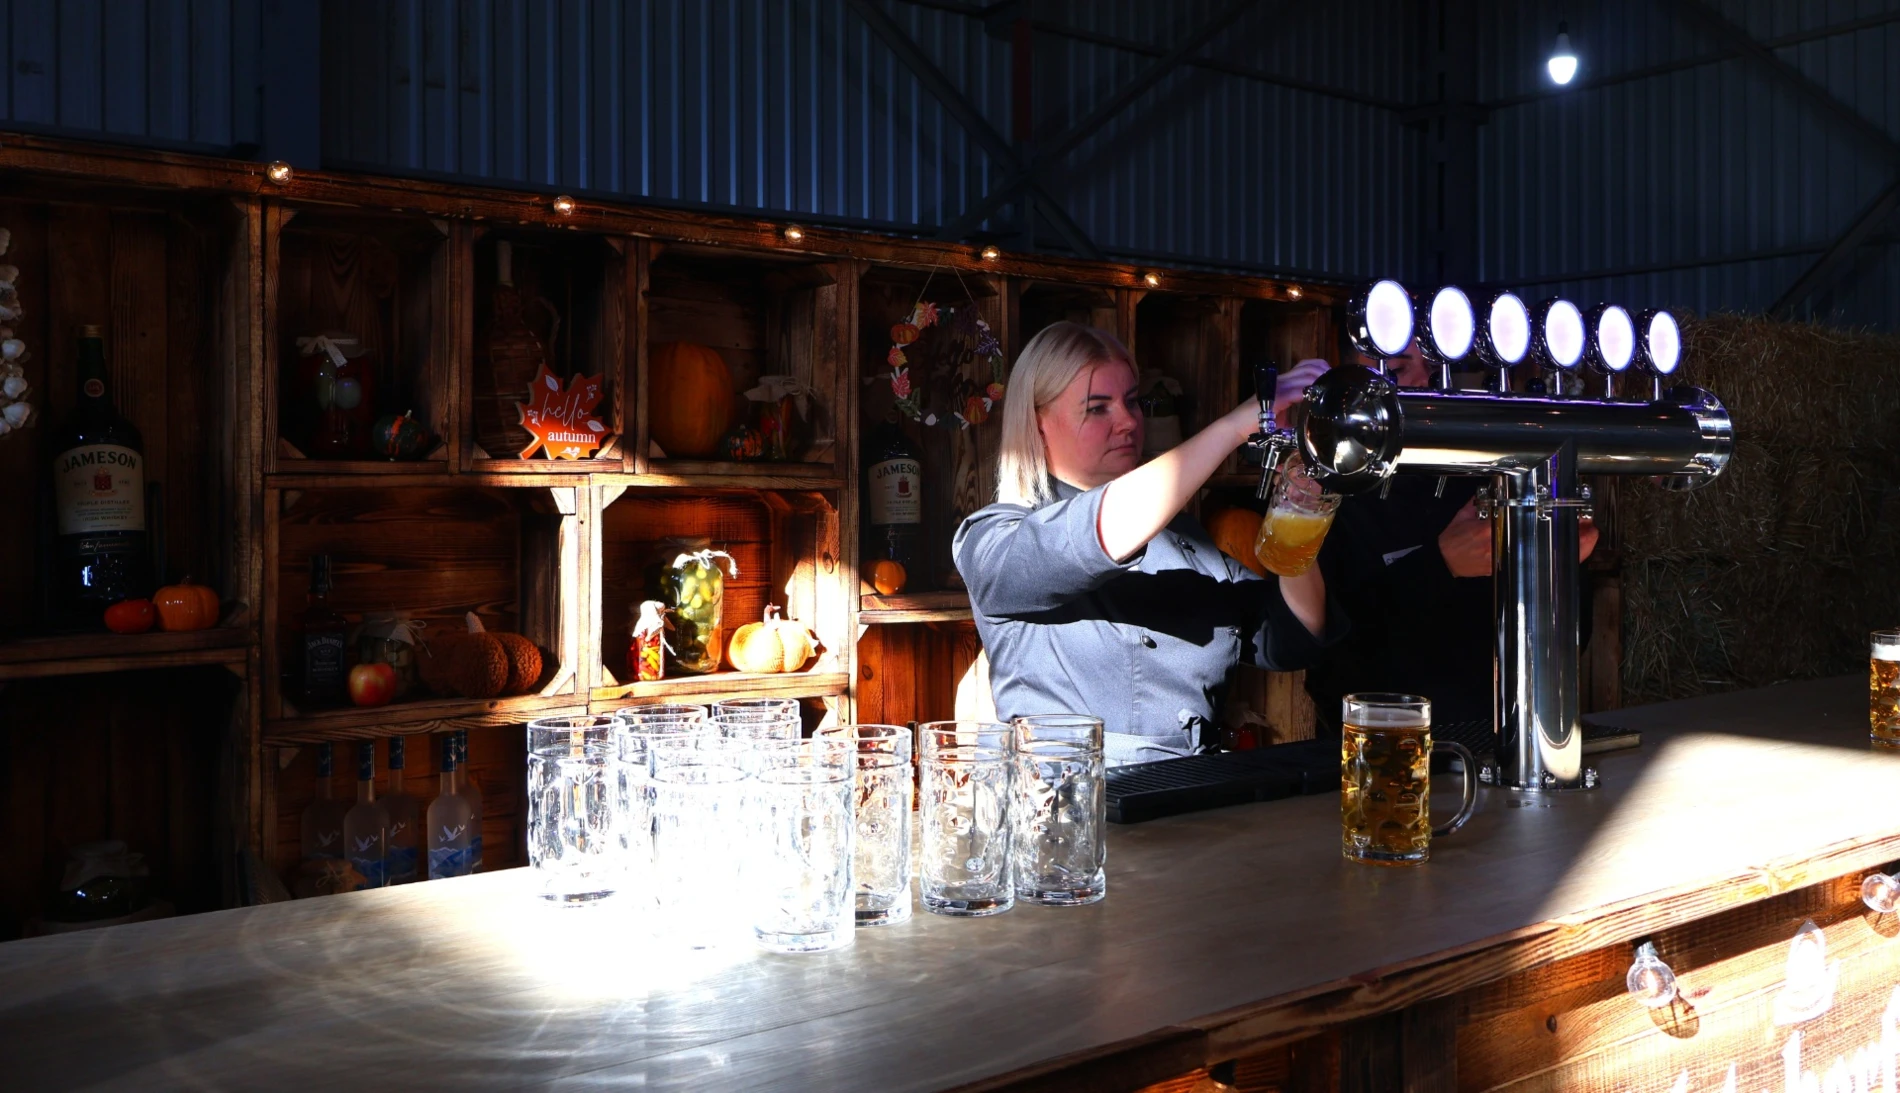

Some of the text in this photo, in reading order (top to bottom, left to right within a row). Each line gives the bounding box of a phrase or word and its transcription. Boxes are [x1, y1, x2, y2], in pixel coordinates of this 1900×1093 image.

[541, 393, 588, 431] hello
[547, 431, 596, 443] autumn
[63, 451, 136, 473] JAMESON
